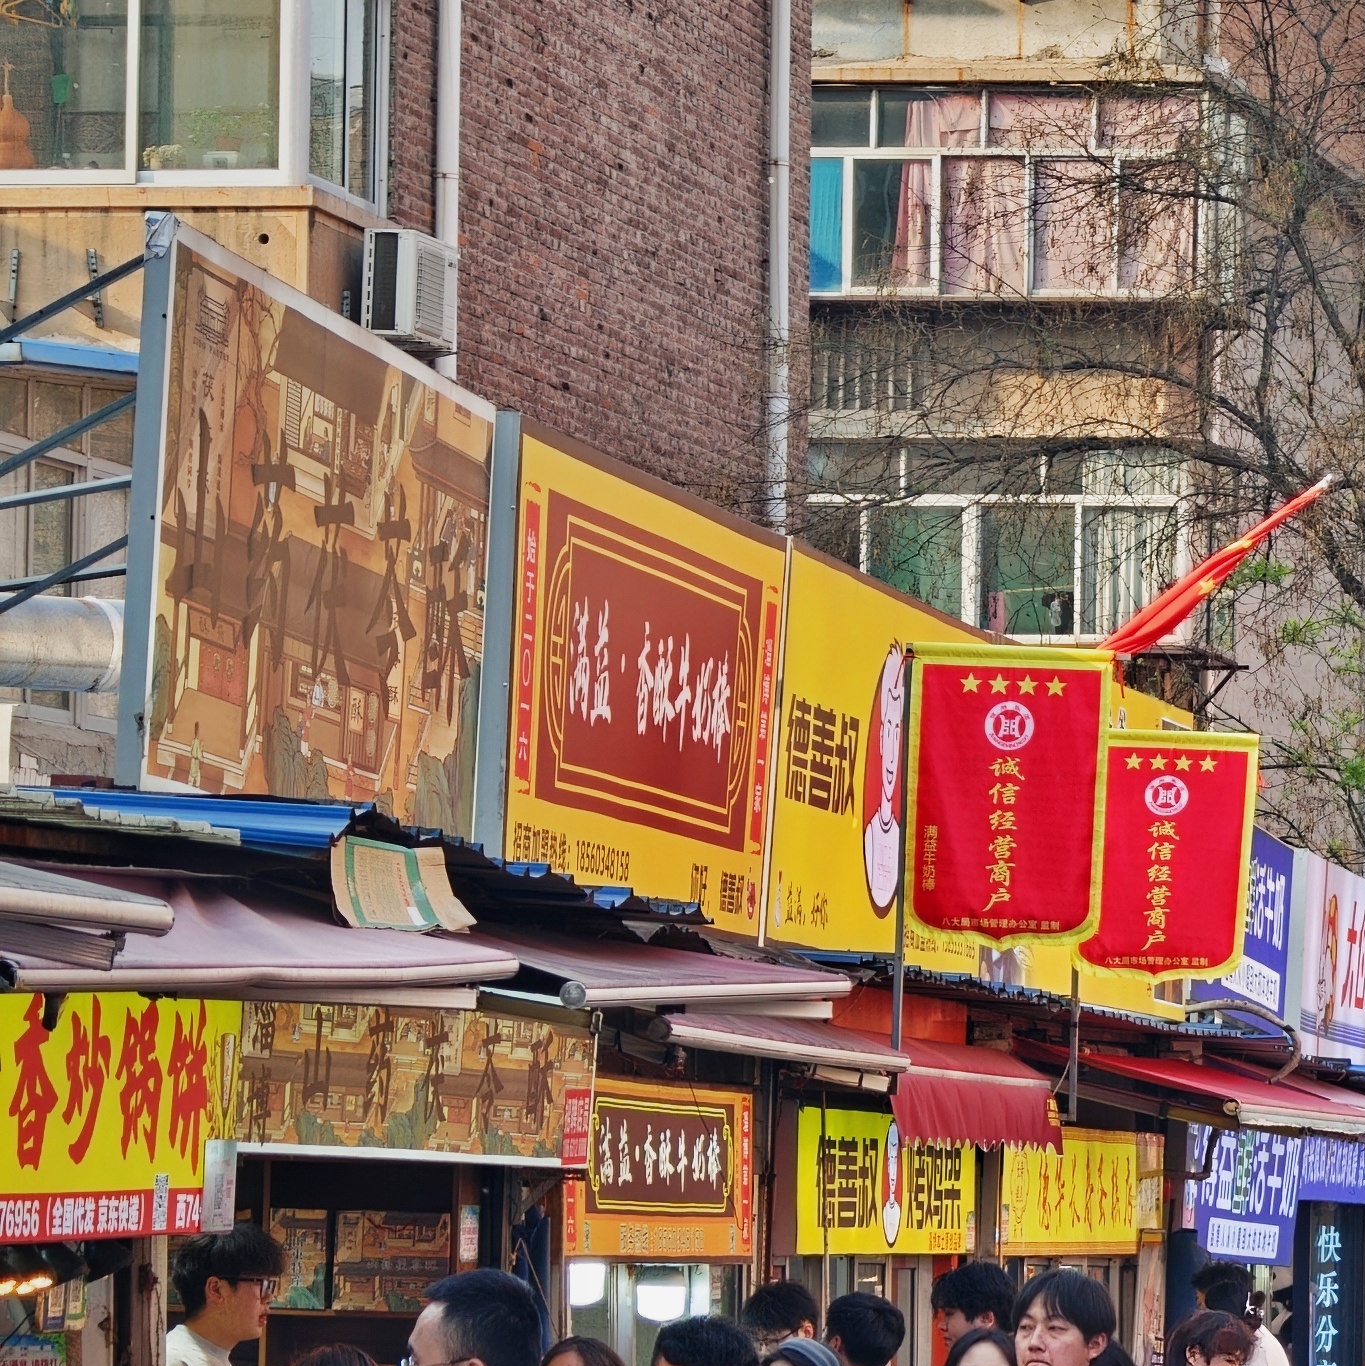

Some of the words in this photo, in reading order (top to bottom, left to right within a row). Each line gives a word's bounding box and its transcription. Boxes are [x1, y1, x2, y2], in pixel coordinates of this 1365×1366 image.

[785, 693, 860, 818] 德善叔
[921, 825, 938, 892] 满益牛奶棒
[982, 757, 1025, 913] 诚信经营商户
[1141, 820, 1180, 951] 诚信经营商户
[816, 1135, 879, 1229] 德善叔
